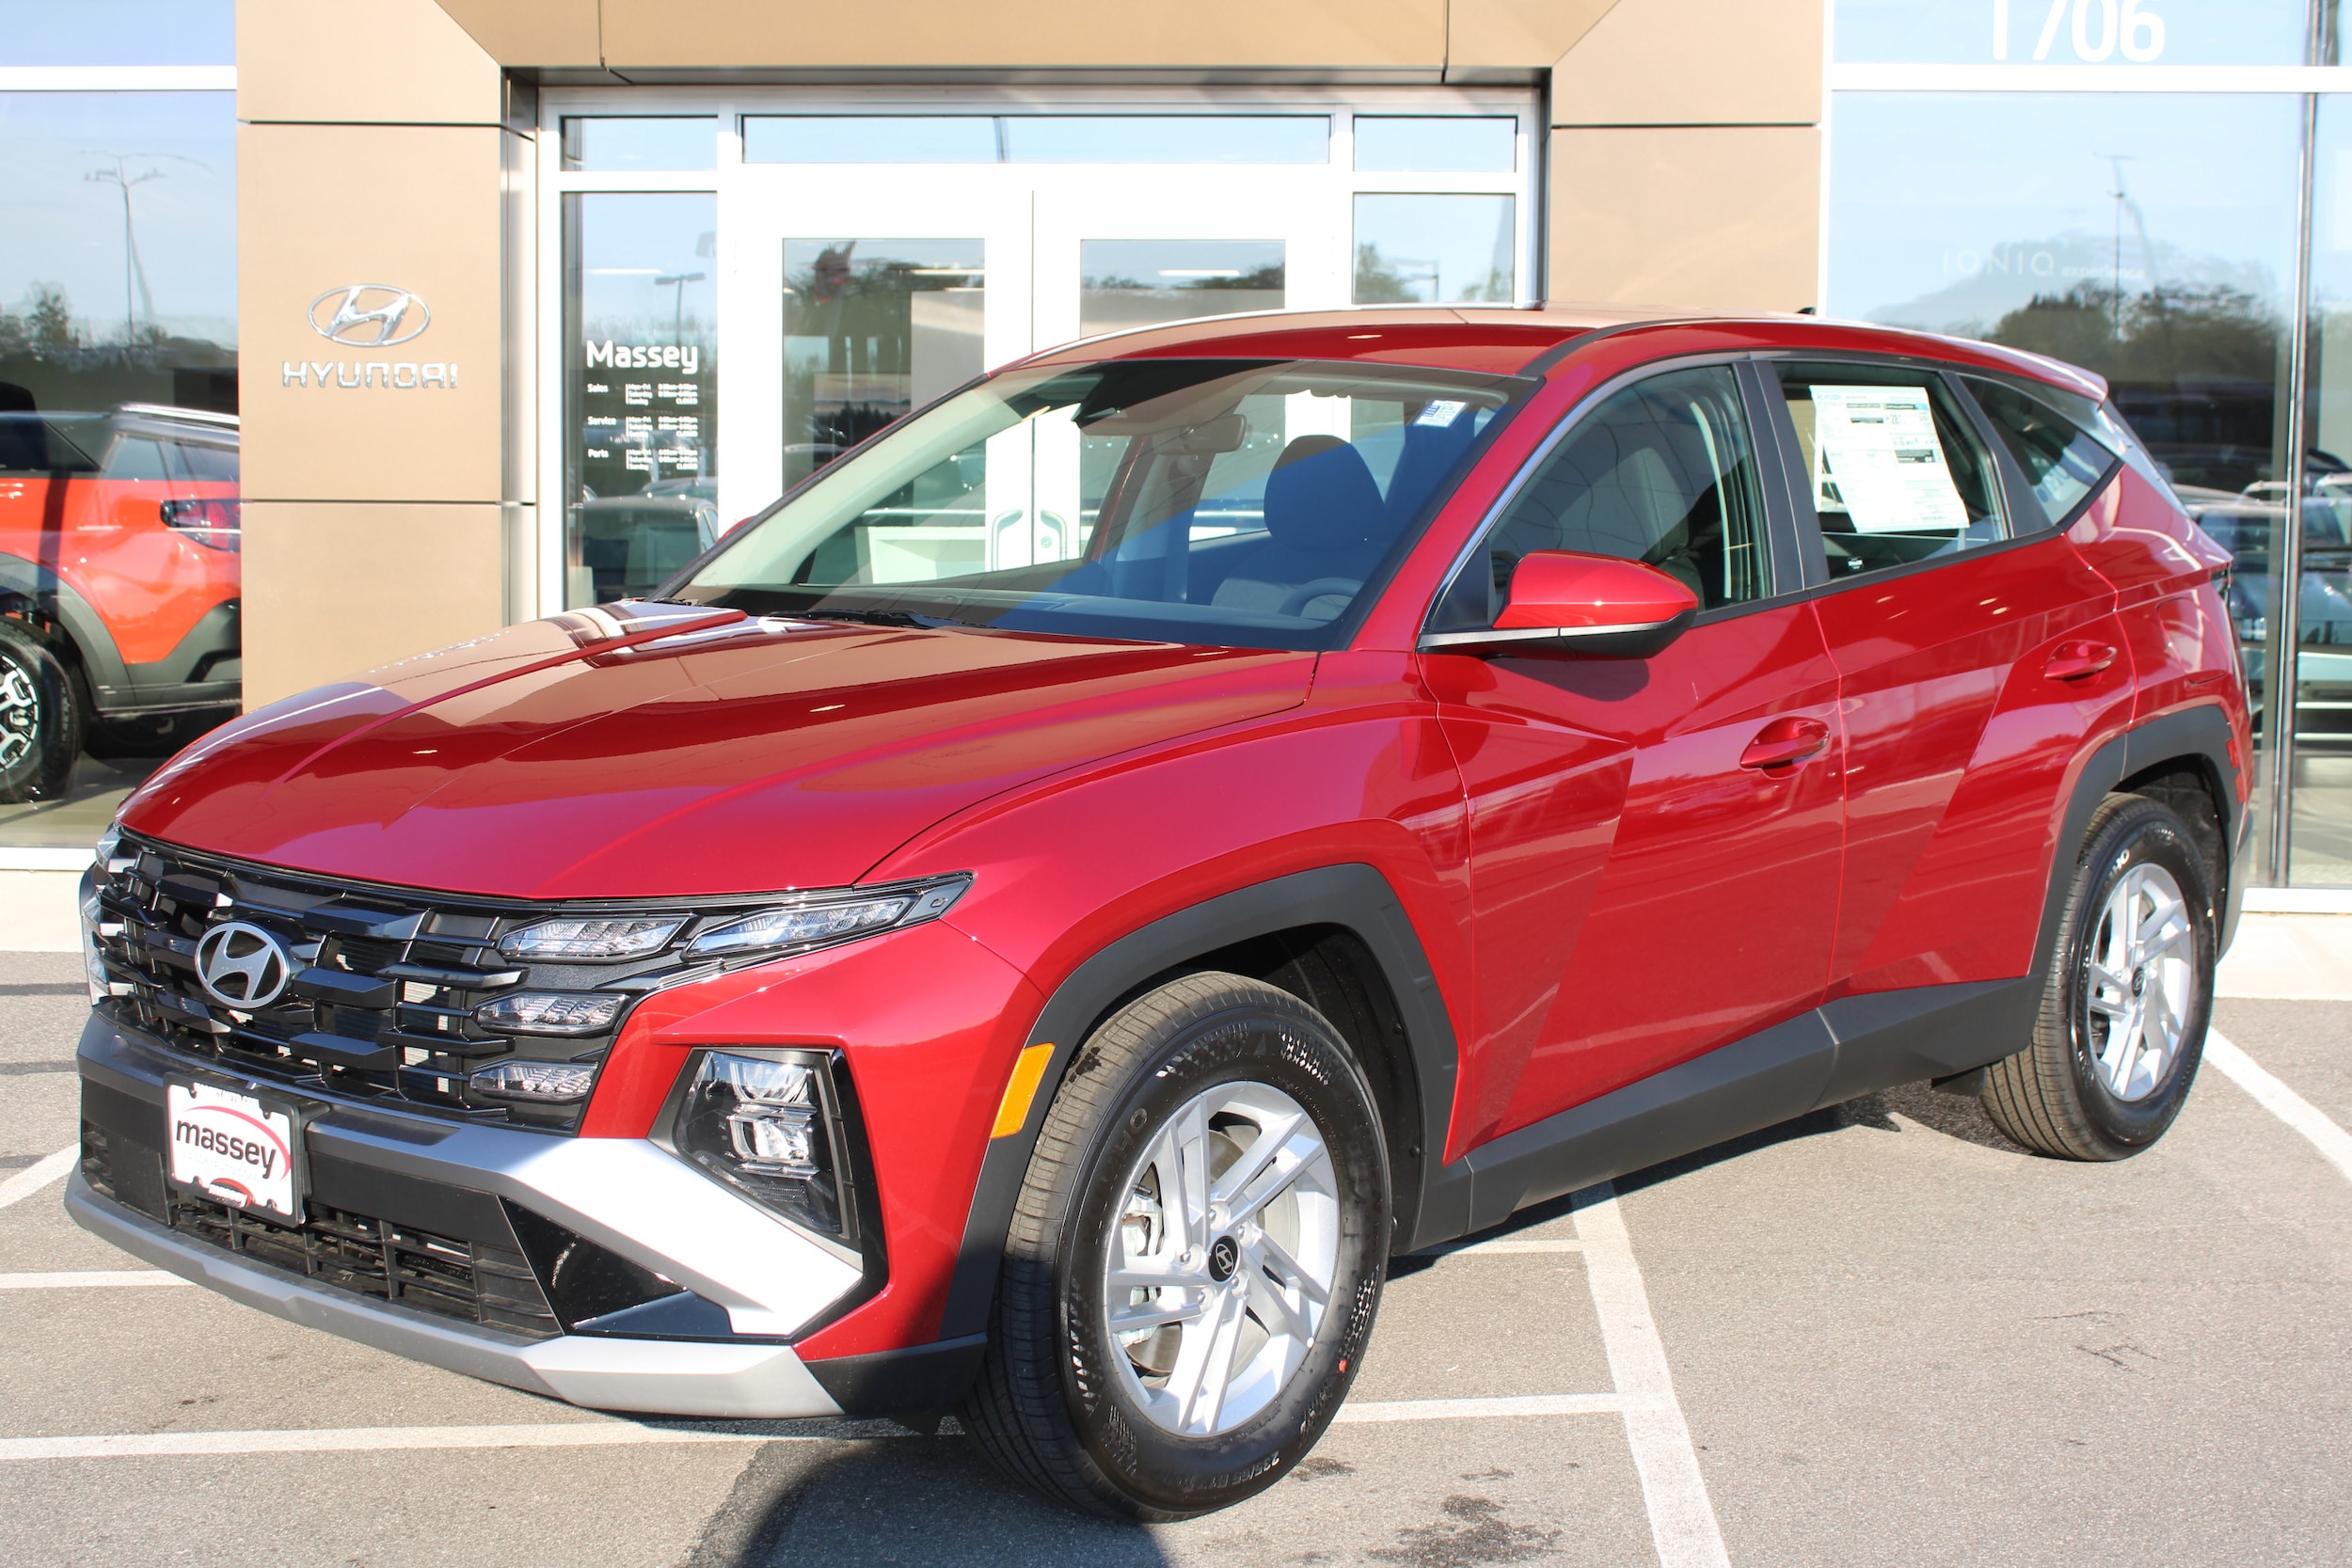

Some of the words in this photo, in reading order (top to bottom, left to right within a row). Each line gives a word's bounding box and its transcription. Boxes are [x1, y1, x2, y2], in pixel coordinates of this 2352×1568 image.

[1993, 0, 2166, 62] 1706
[1942, 249, 2056, 277] IONIQ
[2062, 262, 2146, 279] experience
[586, 340, 699, 374] Massey
[282, 360, 458, 389] HYUNDAI
[587, 384, 610, 393] Sales
[587, 416, 616, 426] Service
[588, 449, 610, 458] Parts
[176, 1120, 276, 1180] massey
